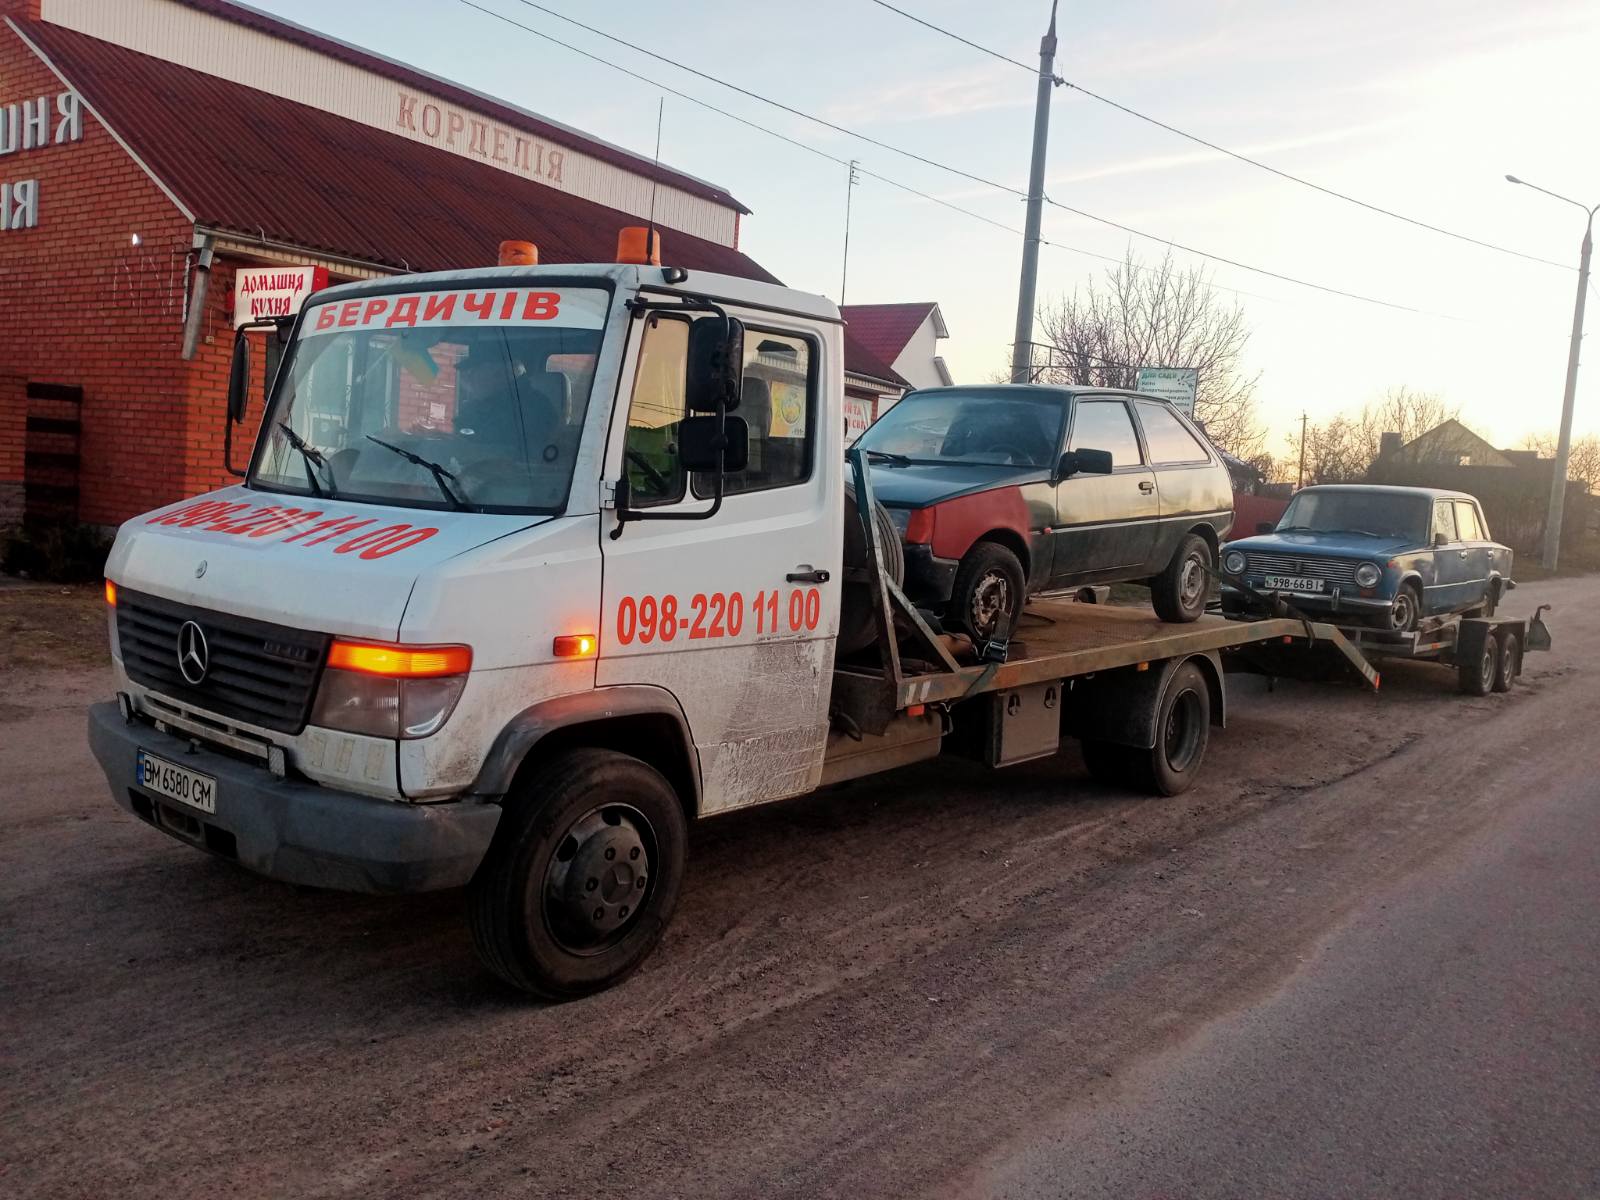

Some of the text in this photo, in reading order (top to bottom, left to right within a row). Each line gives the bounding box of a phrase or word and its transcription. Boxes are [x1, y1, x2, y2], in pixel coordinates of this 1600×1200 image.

[241, 273, 304, 297] ДОМАШНЯ
[251, 296, 291, 317] КУХНЯ
[315, 292, 560, 330] БЕРДИЧІВ
[281, 515, 379, 547] 11
[333, 524, 439, 560] 00
[617, 588, 820, 645] 098-220 11 00
[163, 768, 189, 798] 6580
